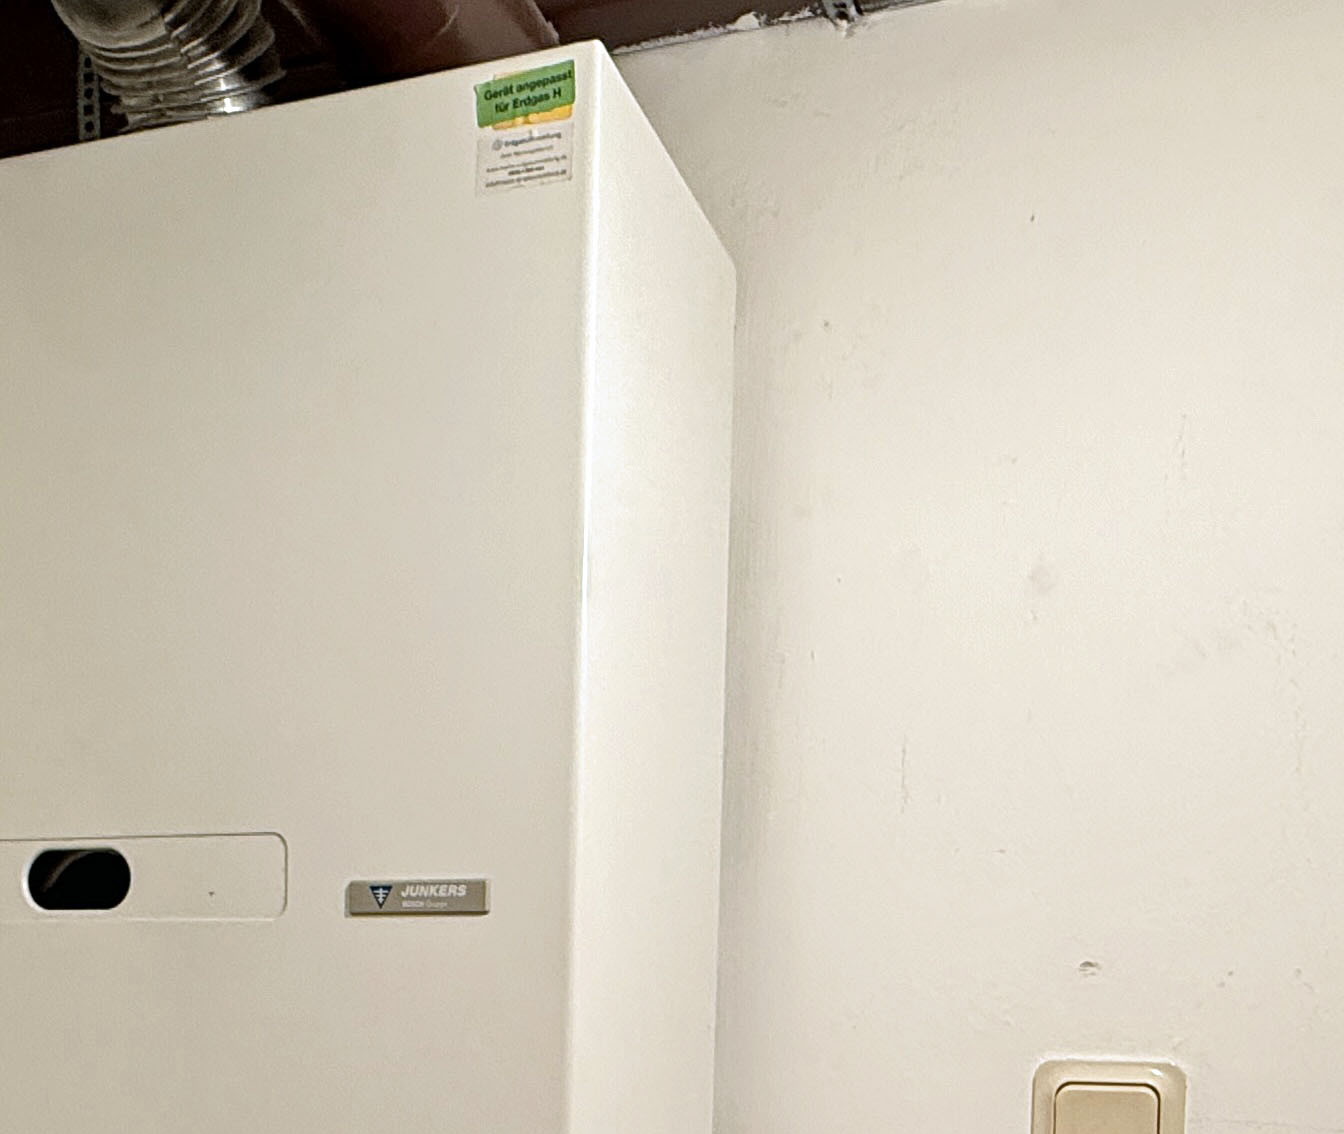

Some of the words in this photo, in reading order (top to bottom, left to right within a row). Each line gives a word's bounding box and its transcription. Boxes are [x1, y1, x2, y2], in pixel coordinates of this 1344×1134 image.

[484, 84, 513, 100] Gerät
[516, 69, 572, 92] angepasst
[495, 101, 509, 113] für
[512, 93, 550, 109] Erdgas
[552, 86, 561, 98] H
[400, 884, 467, 898] JUNKERS
